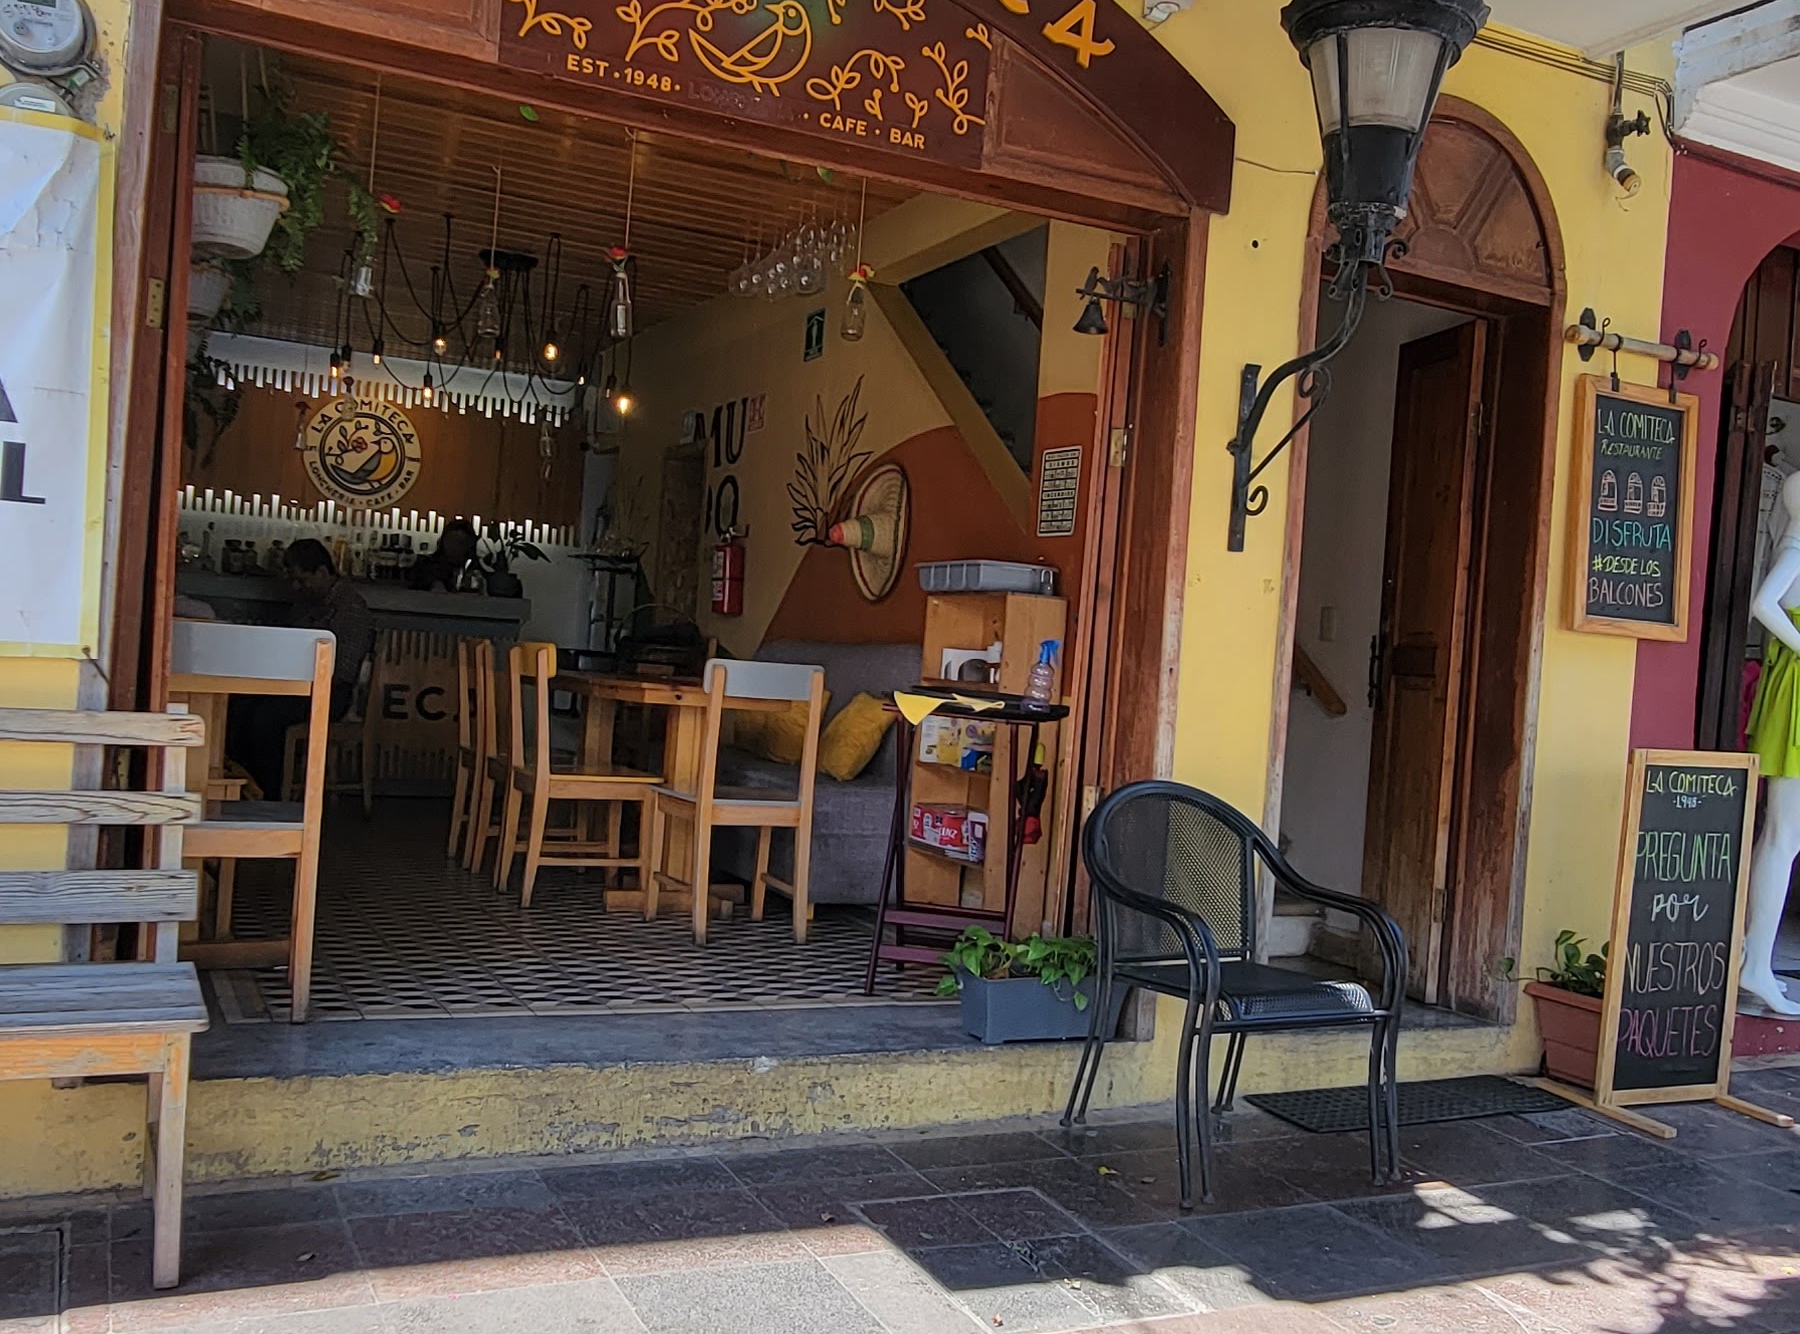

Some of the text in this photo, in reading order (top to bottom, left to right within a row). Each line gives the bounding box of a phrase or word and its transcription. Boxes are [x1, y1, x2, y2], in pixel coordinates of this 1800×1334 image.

[566, 54, 673, 92] EST 1948
[819, 112, 926, 150] CAFE BAR
[310, 413, 334, 434] LA
[1597, 409, 1675, 444] LA COMITECA
[399, 469, 415, 490] BAR
[1592, 517, 1672, 552] DISFRUTA
[1592, 553, 1661, 577] #DESDE LOS
[1588, 577, 1664, 607] BALCONES
[1646, 770, 1738, 797] LA COMITECA
[1635, 831, 1731, 883] PREGUNTA
[1625, 941, 1727, 995] NUESTROS
[1619, 1004, 1717, 1058] PAQUETES
